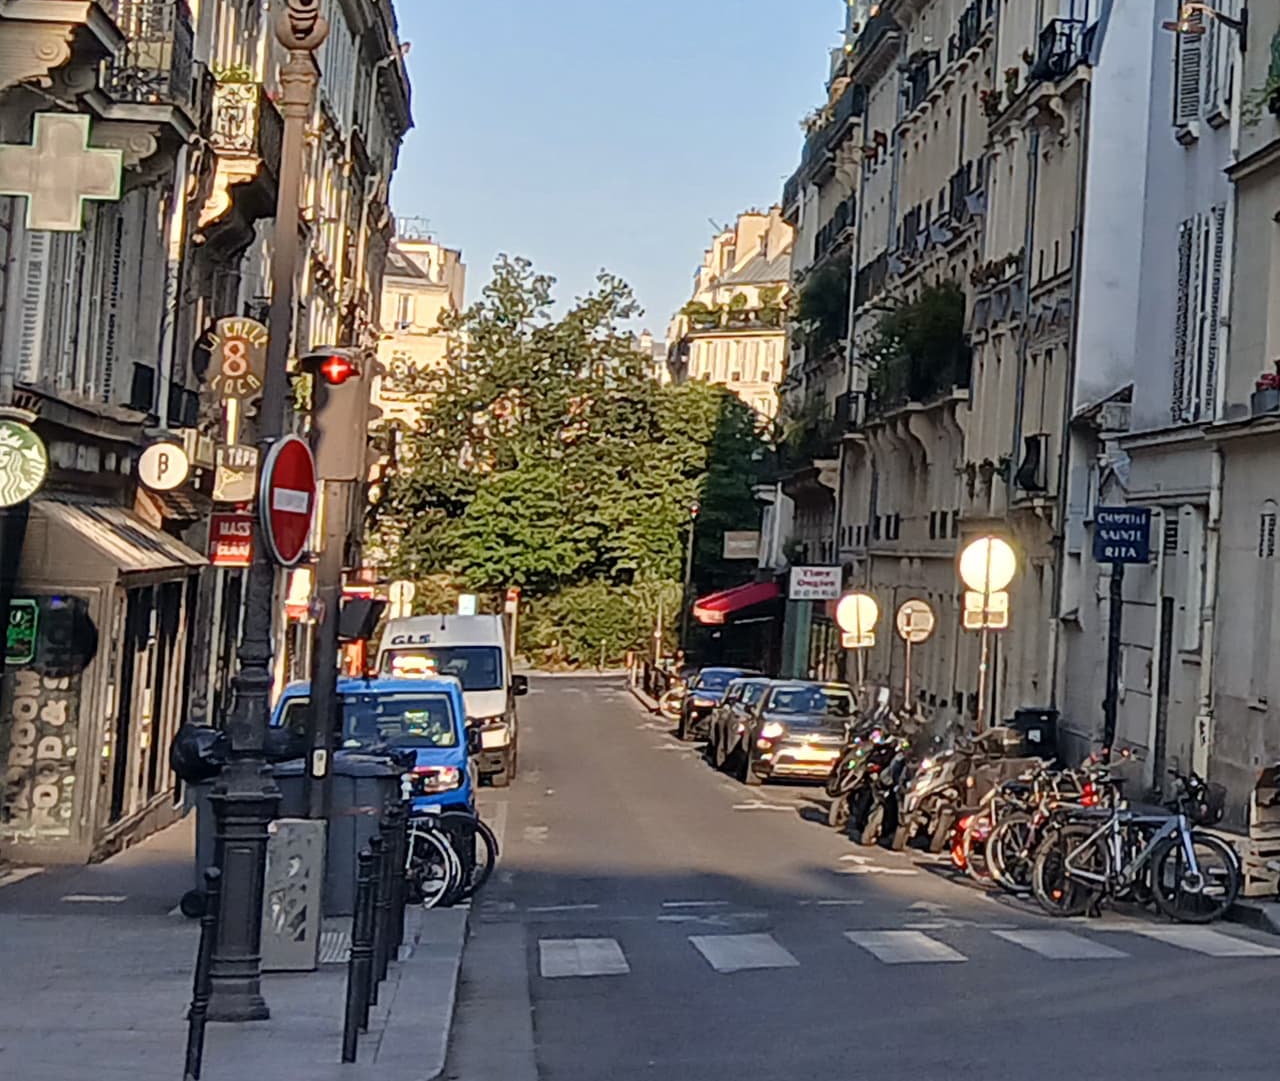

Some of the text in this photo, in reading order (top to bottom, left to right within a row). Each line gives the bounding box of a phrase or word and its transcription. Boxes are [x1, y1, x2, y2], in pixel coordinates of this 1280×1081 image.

[222, 321, 268, 350] CALLE
[222, 340, 248, 377] 8
[211, 374, 261, 396] LOCA
[1104, 546, 1137, 558] RITA
[391, 634, 431, 646] GLS
